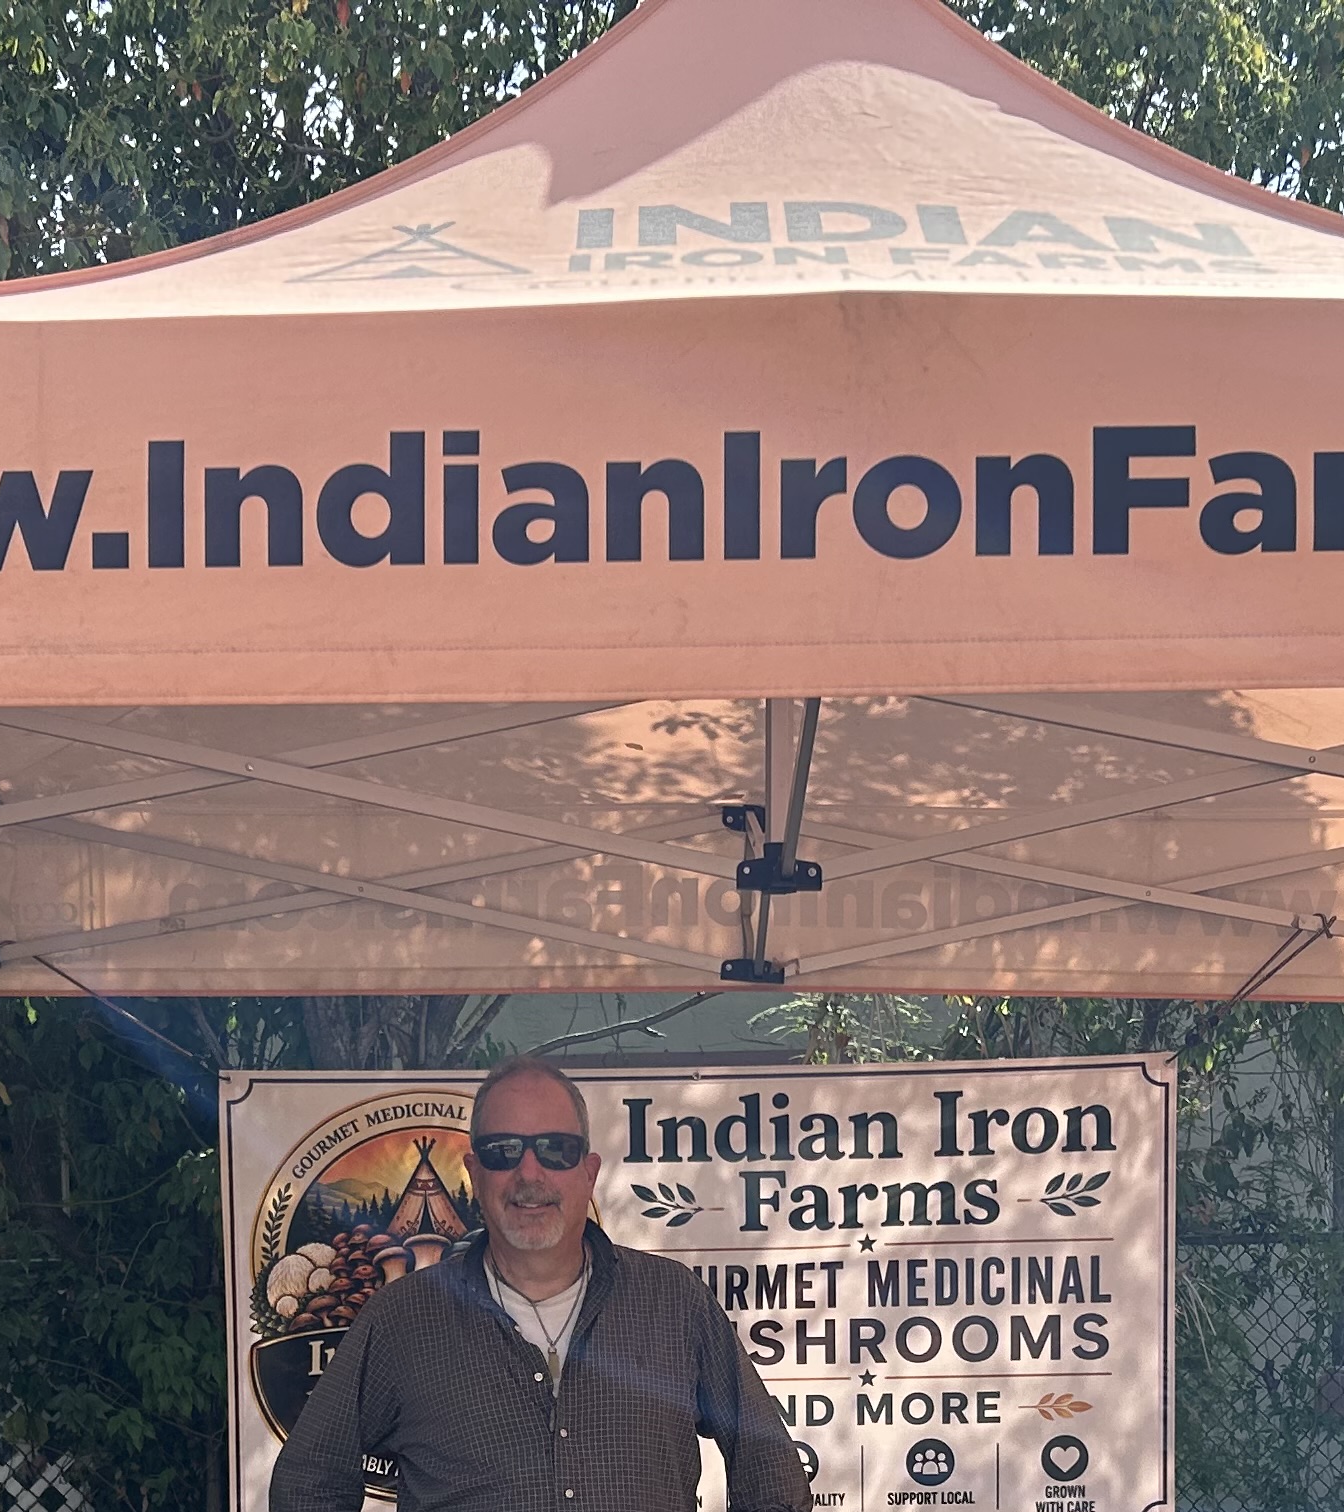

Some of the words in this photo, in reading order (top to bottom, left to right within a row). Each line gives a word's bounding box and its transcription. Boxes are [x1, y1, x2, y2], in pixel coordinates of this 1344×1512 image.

[576, 202, 1255, 257] INDIAN
[568, 247, 850, 272] IRON
[889, 248, 1279, 274] FARMS
[292, 1120, 360, 1181] GOURMET
[366, 1102, 467, 1127] MEDICINAL
[622, 1093, 903, 1164] Indian
[934, 1091, 1116, 1157] Iron
[739, 1169, 1000, 1232] Farms
[867, 1255, 1112, 1307] MEDICINAL
[732, 1314, 1110, 1366] SHROOMS
[770, 1394, 835, 1427] ND
[856, 1391, 1001, 1425] MORE
[811, 1493, 845, 1506] ALITY
[887, 1492, 937, 1506] SUPPORT
[941, 1491, 975, 1505] LOCAL
[1045, 1485, 1085, 1498] GROWN
[1067, 1499, 1095, 1512] CARE
